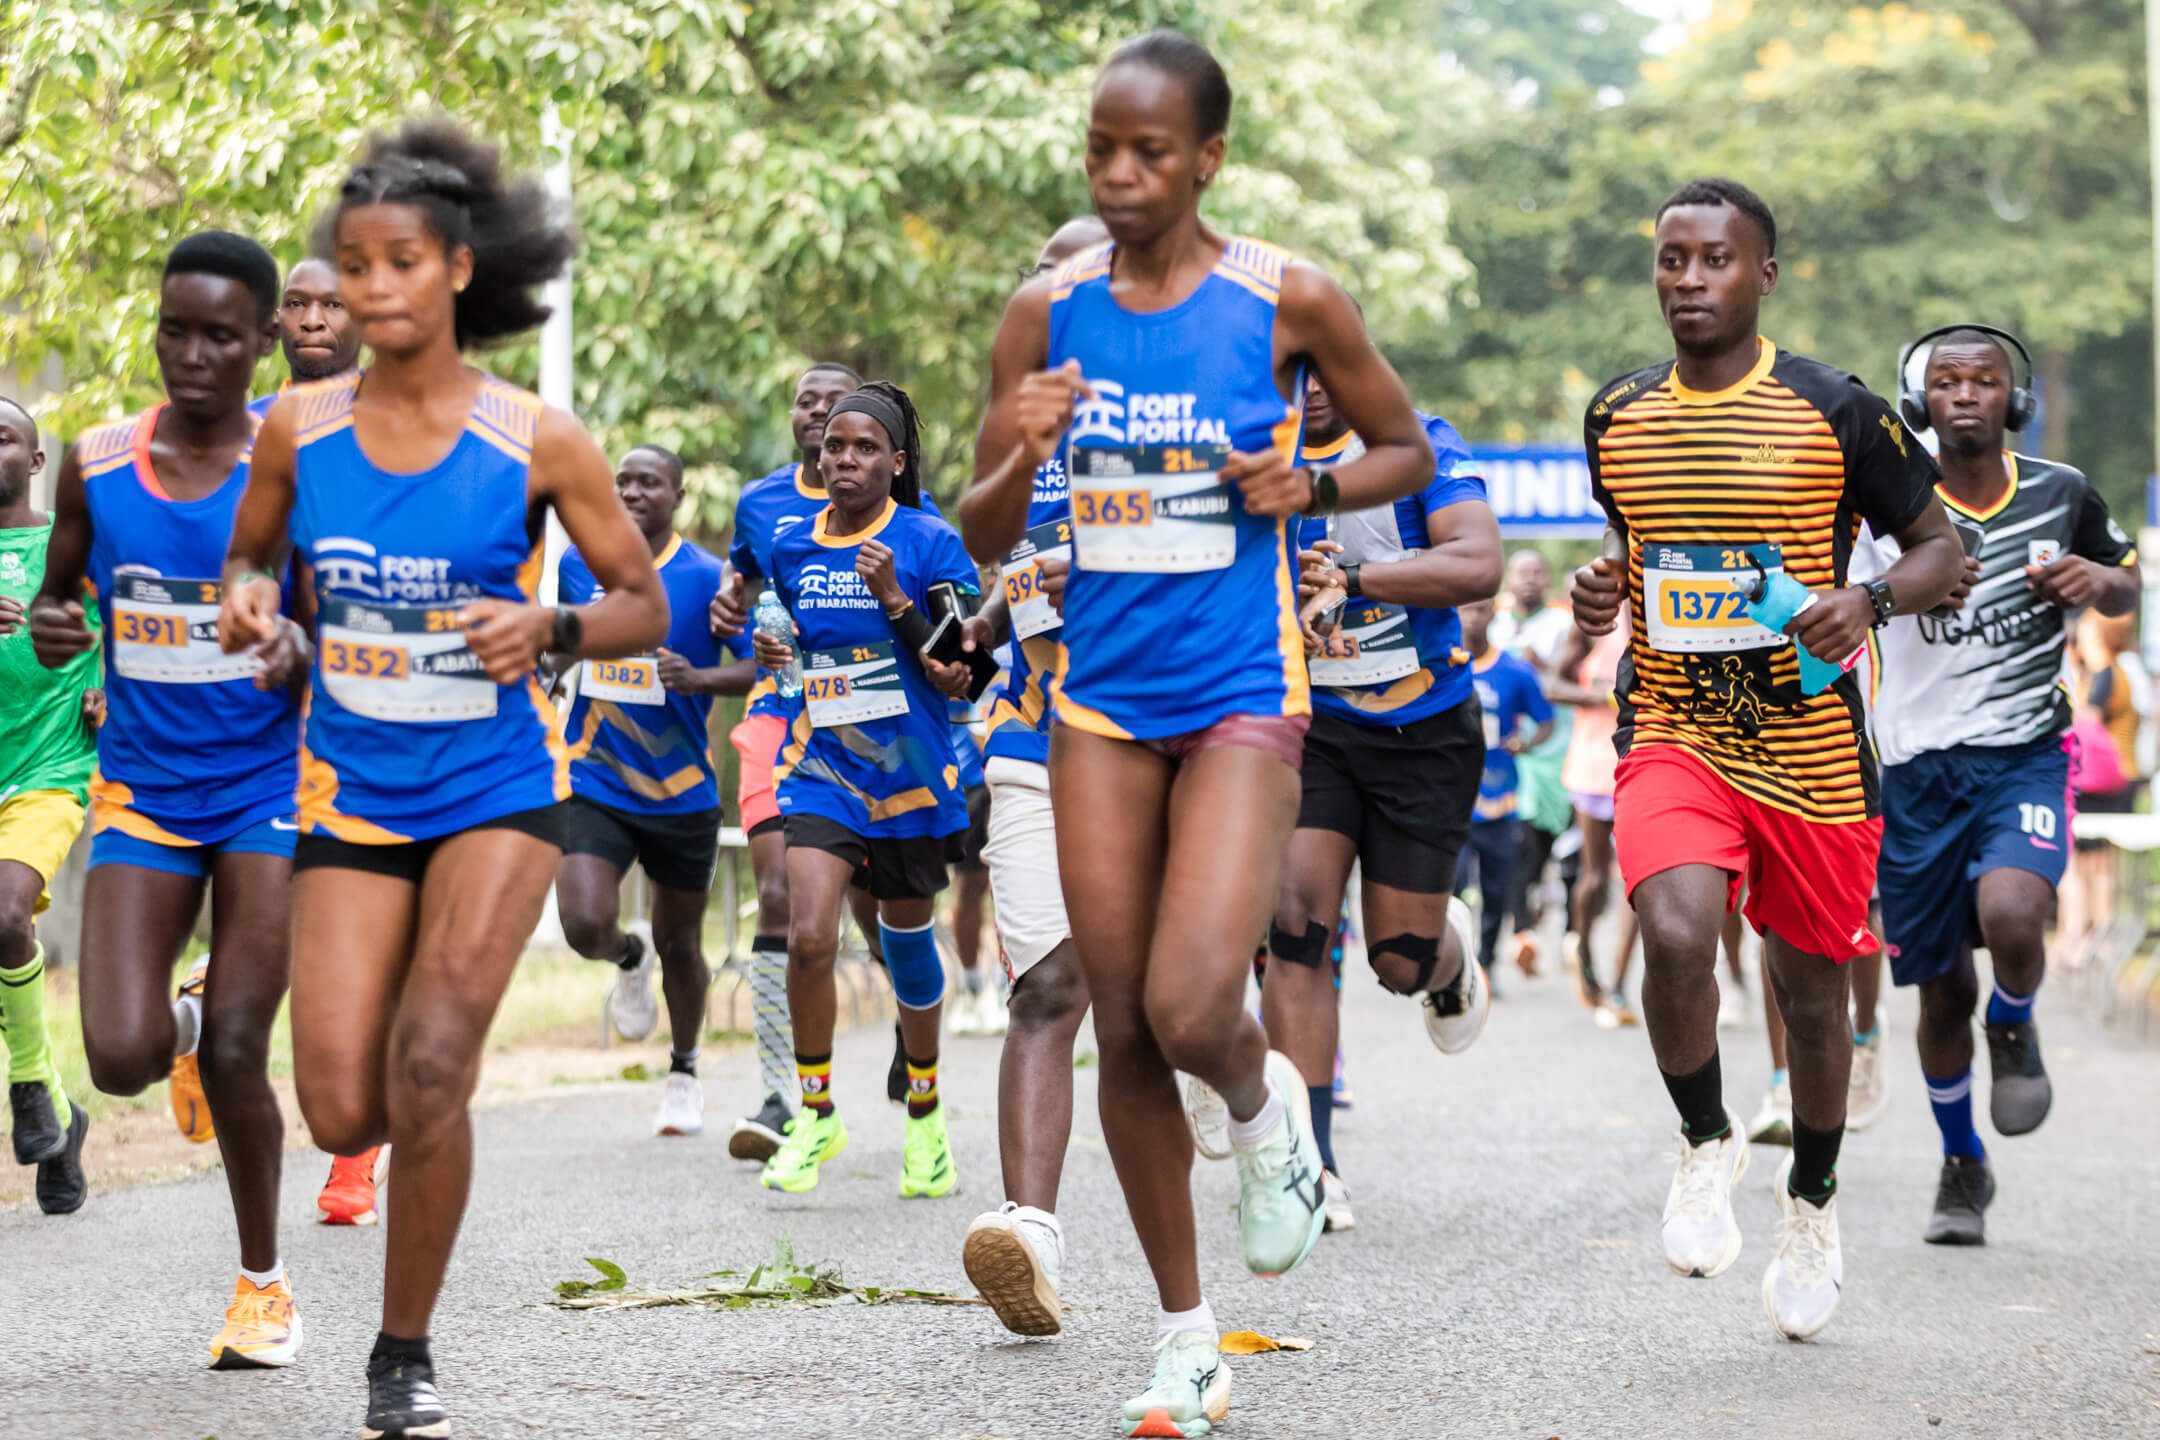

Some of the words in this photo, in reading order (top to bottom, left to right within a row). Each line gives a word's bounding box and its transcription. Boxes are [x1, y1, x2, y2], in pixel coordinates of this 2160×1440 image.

[1128, 393, 1196, 418] FORT
[1127, 418, 1231, 444] PORTAL
[1476, 459, 1606, 517] INI
[1079, 493, 1145, 525] 365
[380, 555, 451, 580] FORT
[827, 584, 872, 596] PORTA
[1007, 567, 1043, 602] 396
[798, 598, 815, 609] CITY
[816, 598, 879, 609] MARATHON
[1669, 590, 1750, 620] 1372
[122, 614, 175, 645] 391
[329, 643, 402, 678] 352
[432, 653, 484, 673] ABAT
[598, 663, 645, 686] 1382
[807, 677, 847, 699] 478
[2018, 802, 2056, 839] 10
